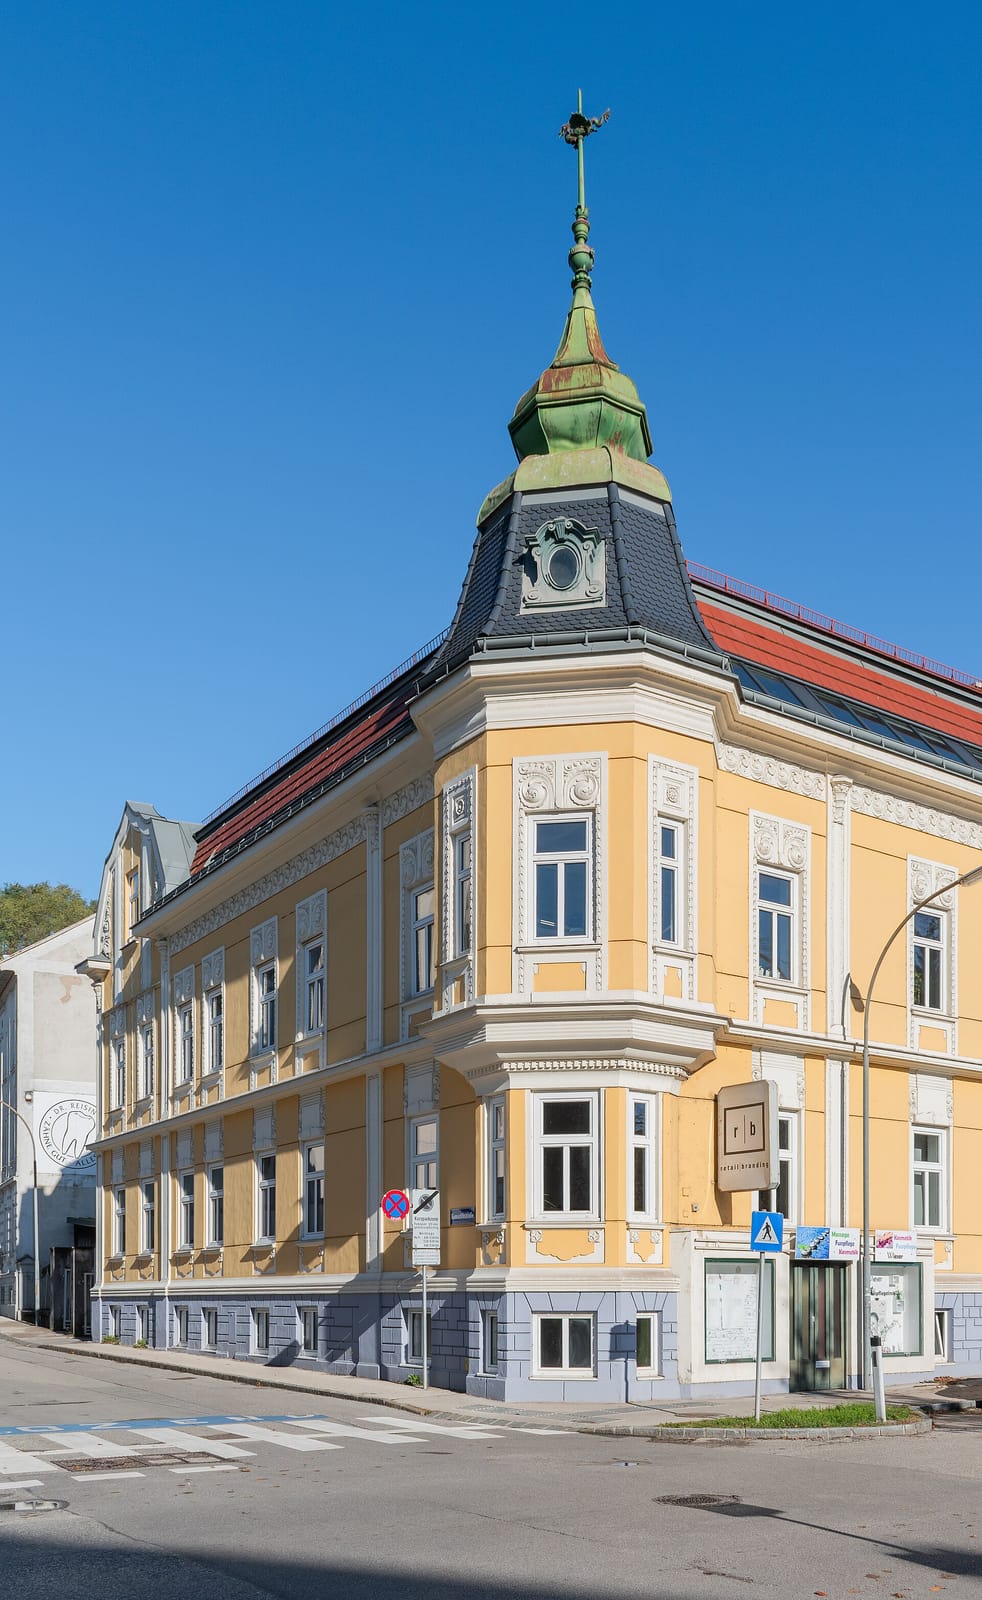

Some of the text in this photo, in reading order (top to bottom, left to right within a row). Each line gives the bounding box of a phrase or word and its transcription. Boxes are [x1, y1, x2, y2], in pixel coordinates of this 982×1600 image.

[734, 1121, 756, 1138] r b
[51, 1150, 66, 1163] GUT
[720, 1161, 769, 1171] retail branding
